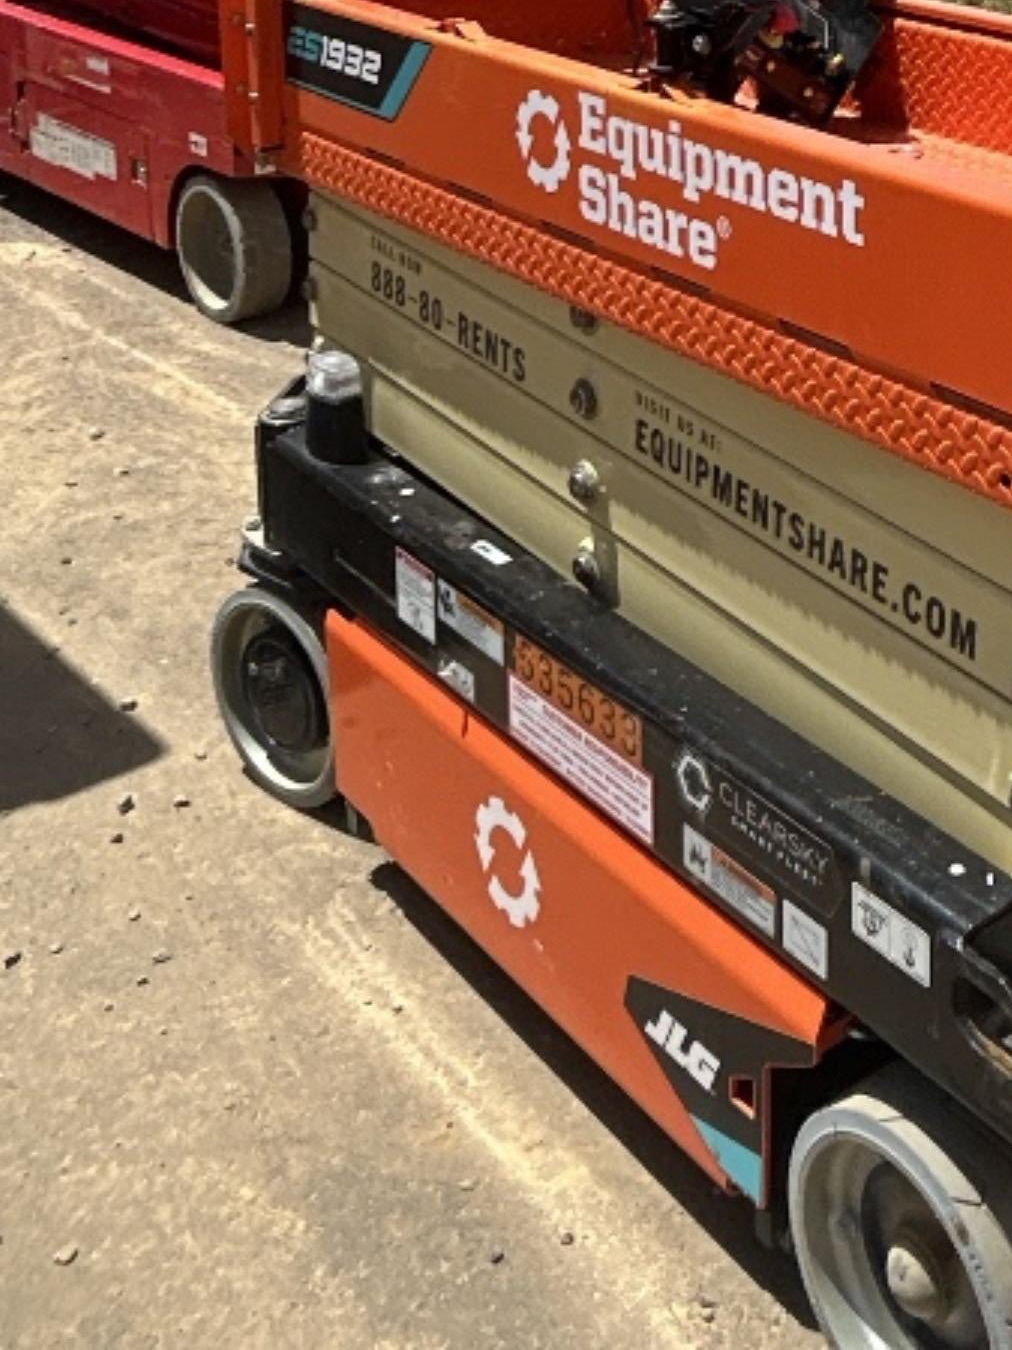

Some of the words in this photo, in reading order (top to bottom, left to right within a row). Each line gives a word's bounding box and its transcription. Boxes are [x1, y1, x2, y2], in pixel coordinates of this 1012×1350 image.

[577, 90, 866, 248] Equipment
[370, 259, 527, 383] 888-80-RENTS
[634, 418, 978, 661] EQUIPMENTSHARE.COM
[718, 780, 830, 876] CLEARSKY
[643, 1007, 721, 1092] JLG
